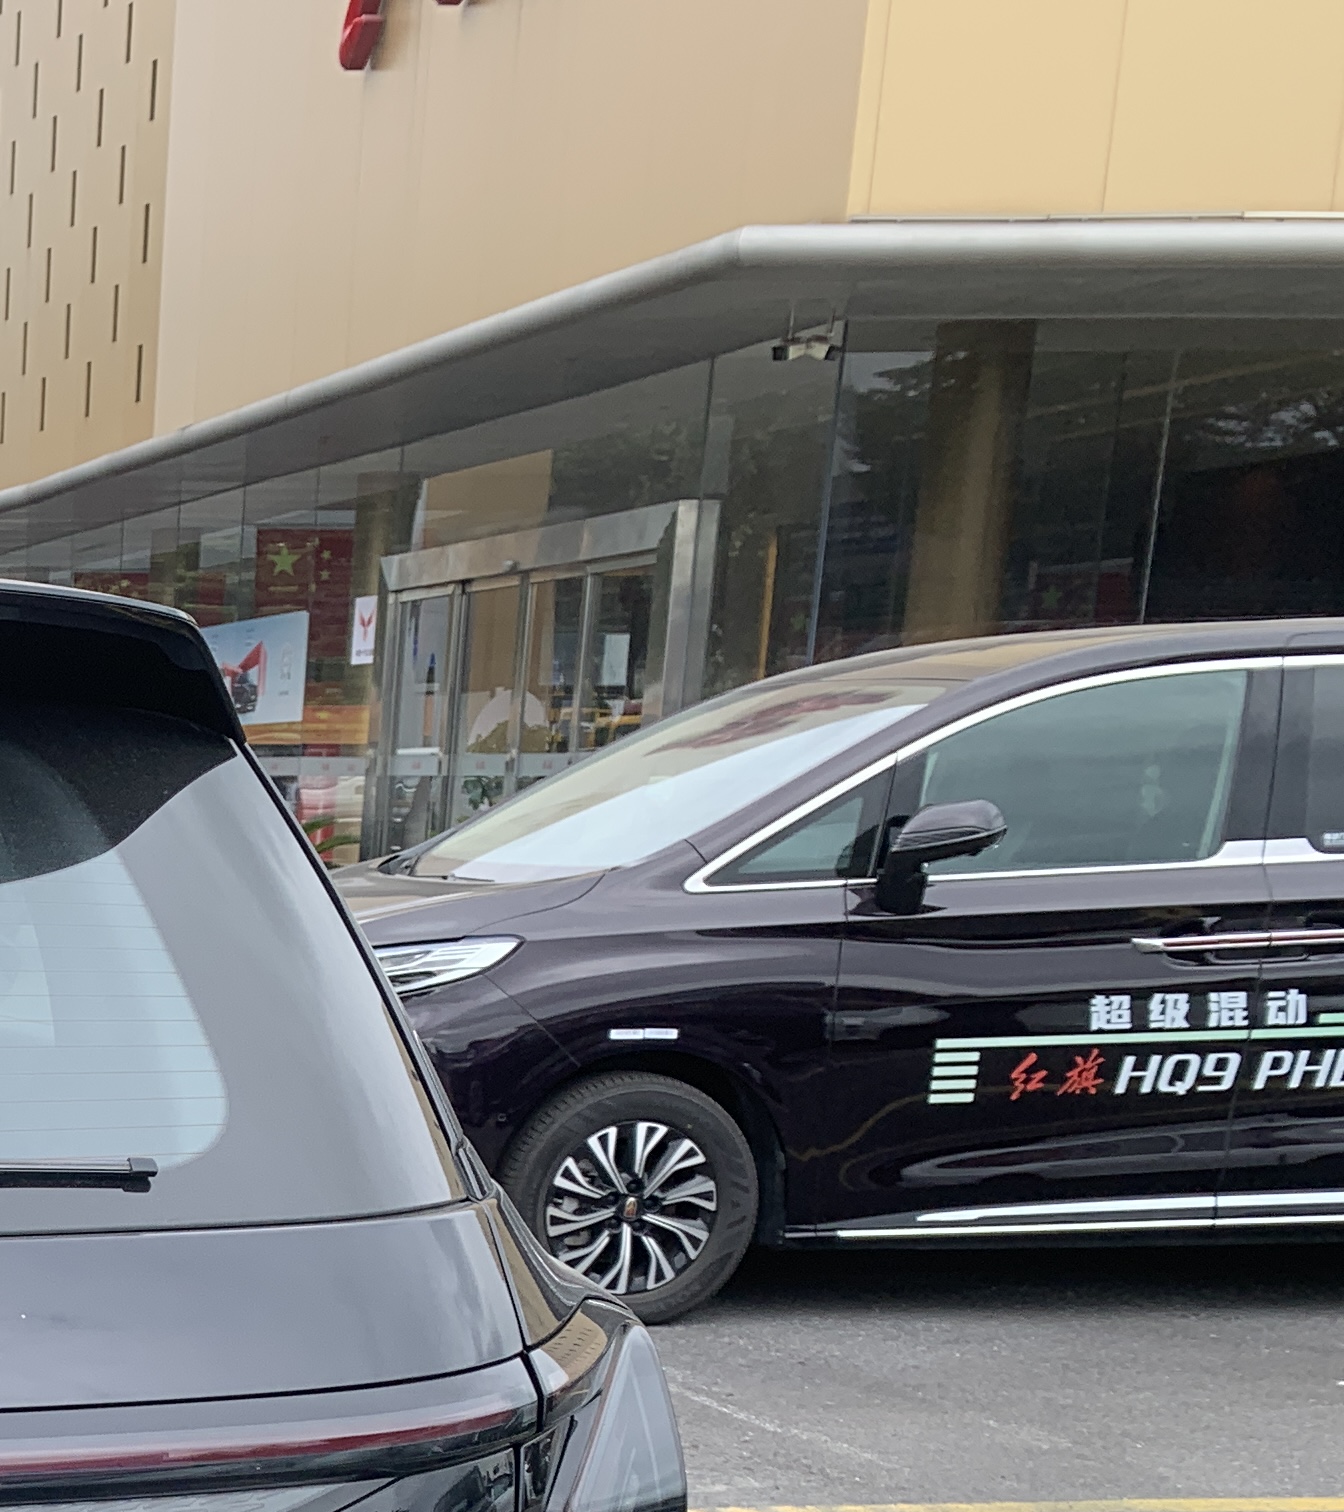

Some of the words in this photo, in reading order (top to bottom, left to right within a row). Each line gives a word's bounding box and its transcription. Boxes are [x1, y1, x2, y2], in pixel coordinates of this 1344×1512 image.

[1089, 989, 1308, 1031] 超级混动
[1008, 1049, 1106, 1101] 红旗
[1113, 1053, 1241, 1096] HQ9
